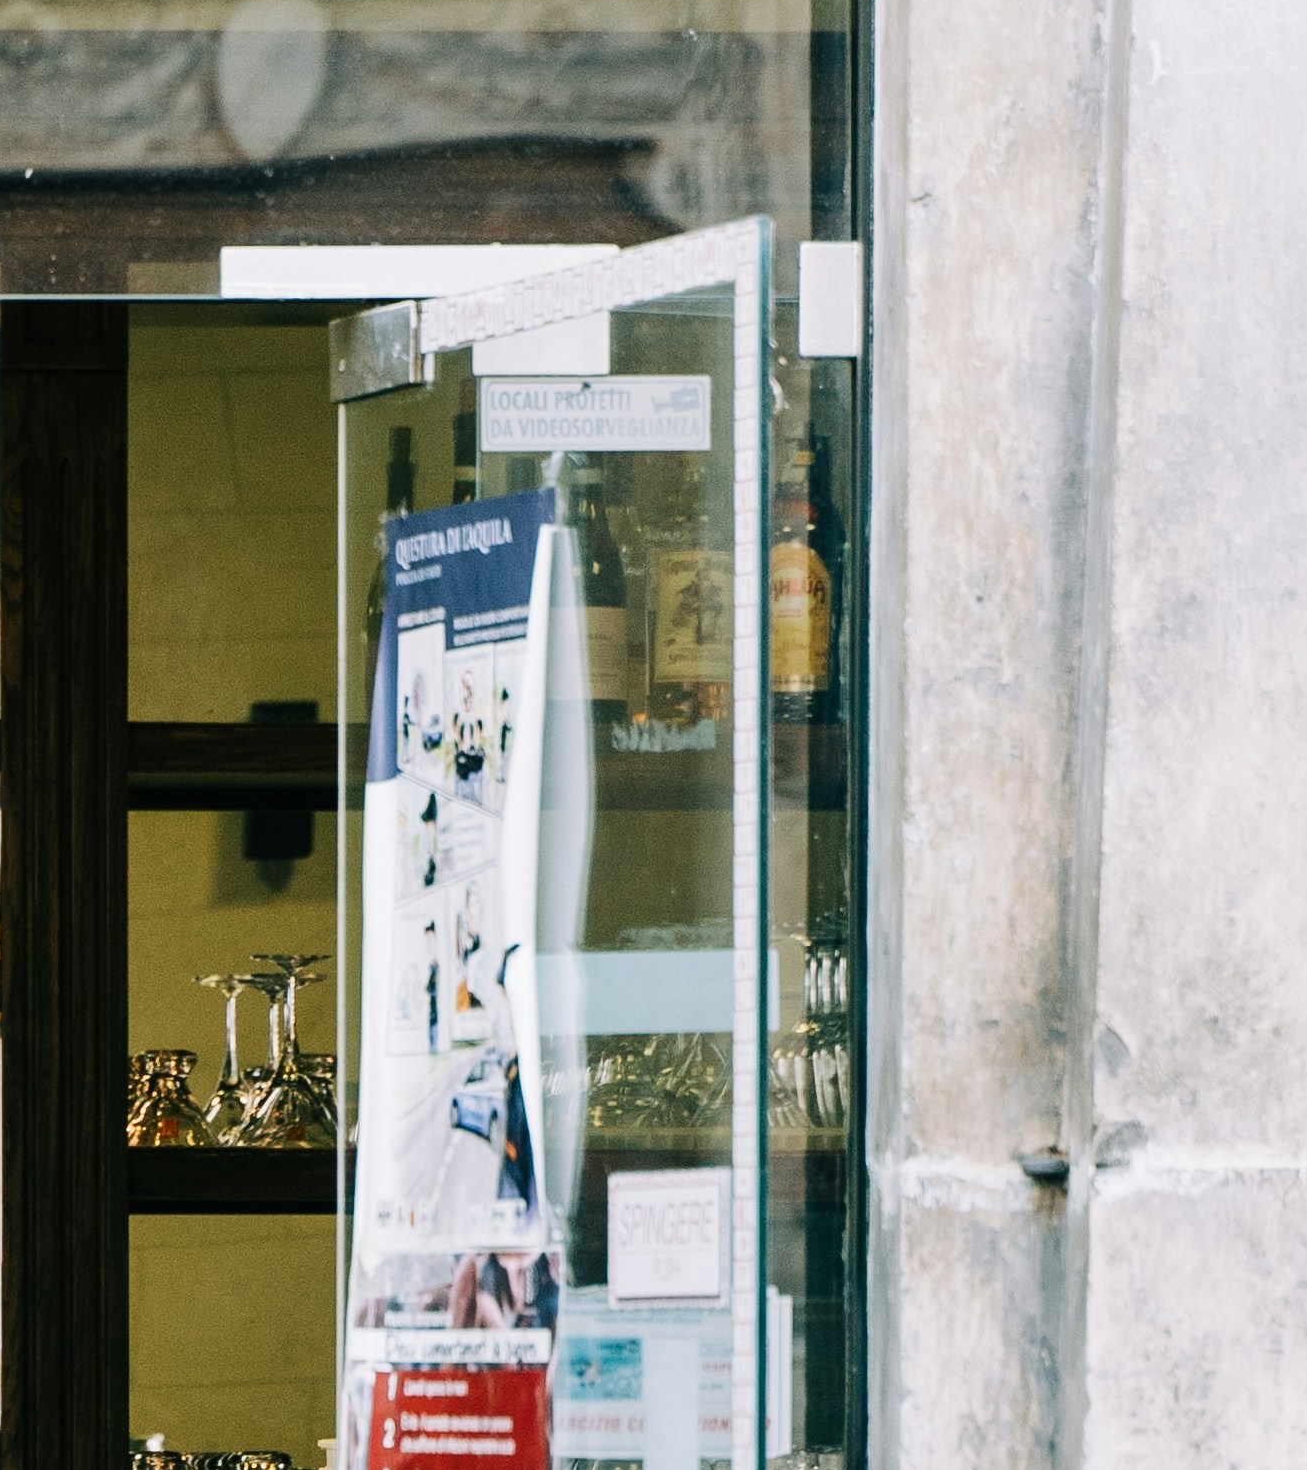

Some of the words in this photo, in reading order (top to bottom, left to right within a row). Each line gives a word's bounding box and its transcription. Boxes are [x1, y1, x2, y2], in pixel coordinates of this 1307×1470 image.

[489, 391, 548, 413] LOCALI
[554, 391, 632, 413] PROTETTI
[489, 417, 513, 439] DA
[518, 417, 703, 439] VIDEOSORVEGLIANZA
[395, 529, 445, 570] QUESTURA
[618, 1199, 715, 1247] SPINGERE
[382, 1417, 396, 1449] 2
